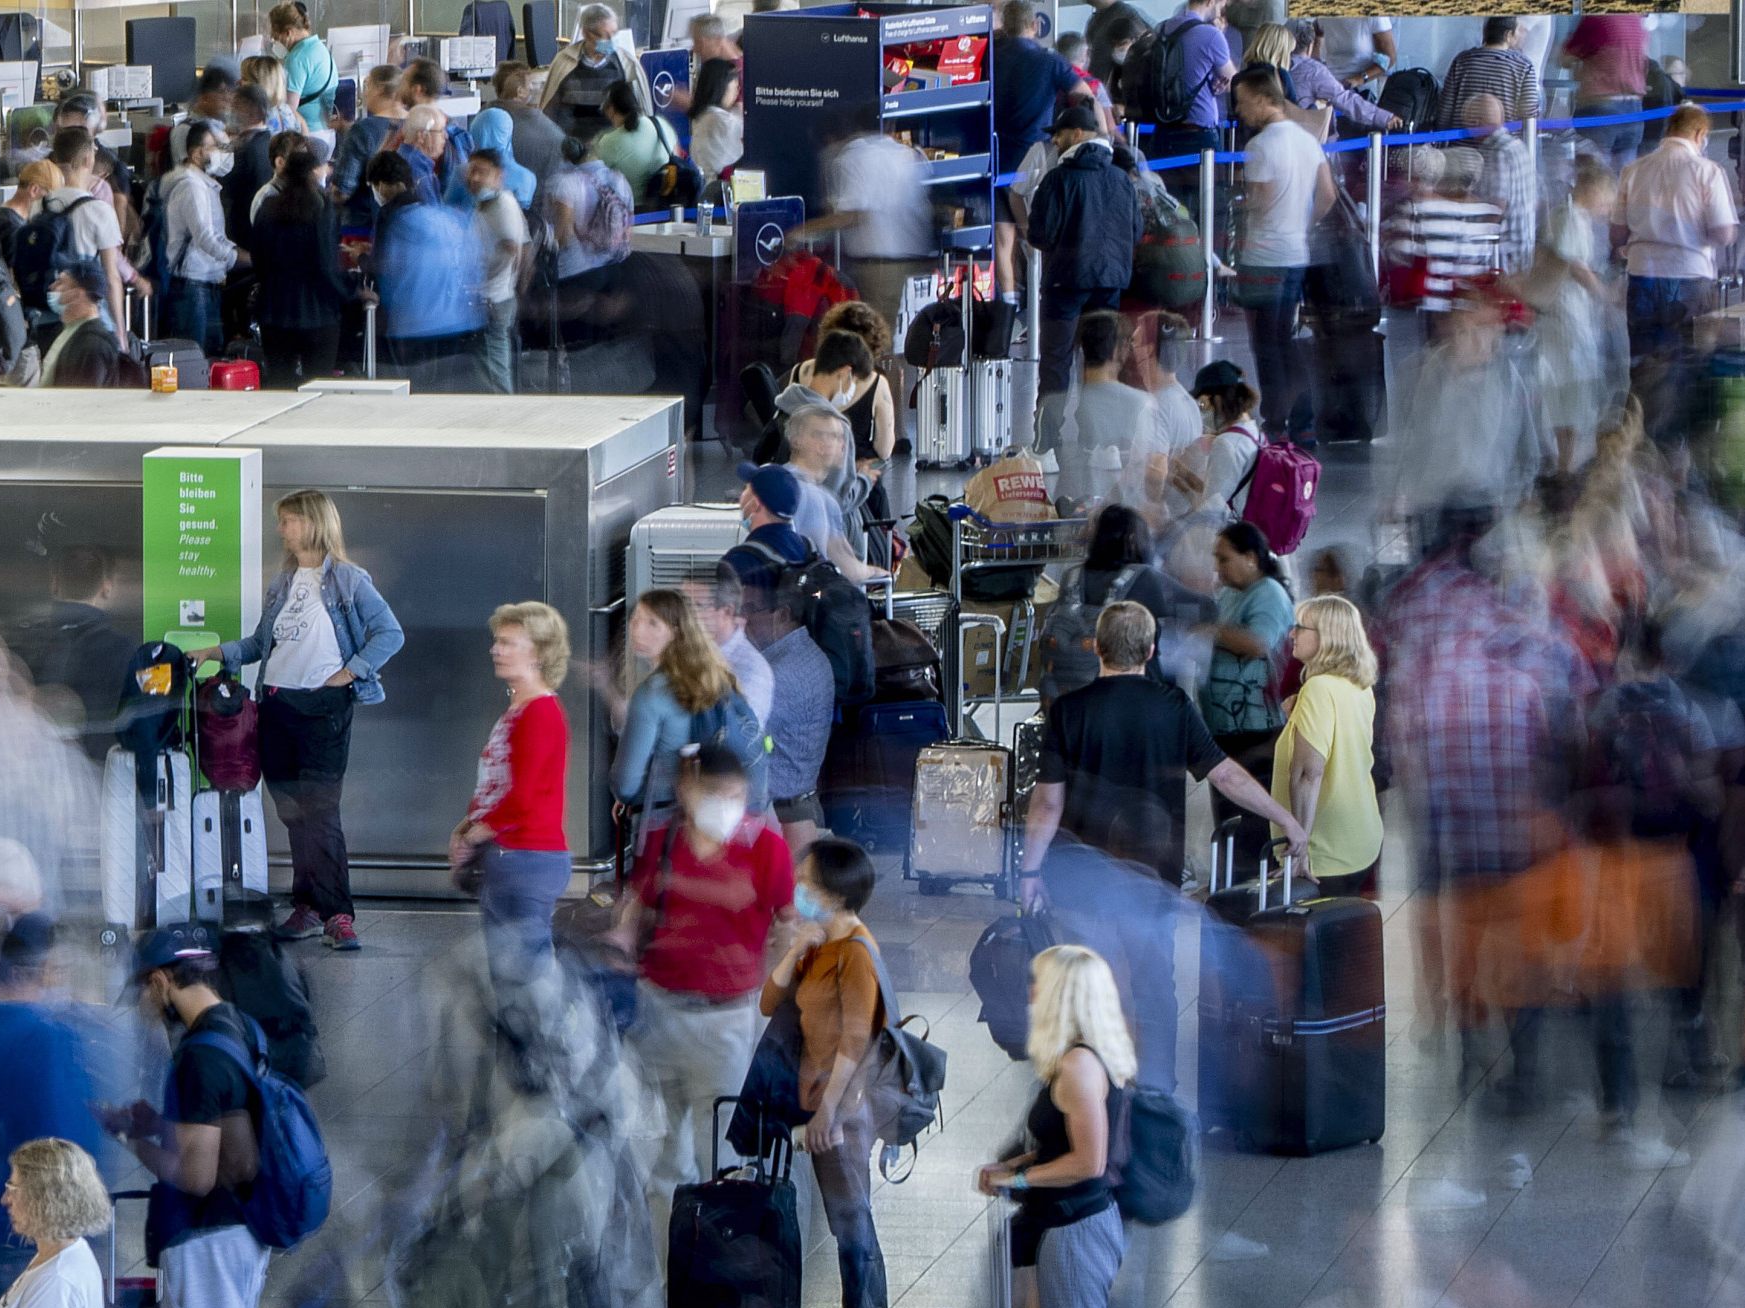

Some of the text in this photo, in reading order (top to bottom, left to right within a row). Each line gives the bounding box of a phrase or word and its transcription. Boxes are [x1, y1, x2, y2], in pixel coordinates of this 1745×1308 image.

[755, 86, 840, 98] Bitte bedienen Sie sich
[755, 96, 824, 108] Please help yourself
[179, 471, 204, 483] Bitte
[997, 475, 1046, 492] REWE
[179, 487, 216, 499] bleiben
[179, 502, 196, 514] Sie
[179, 519, 218, 531] gesund.
[179, 534, 212, 545] Please
[179, 550, 200, 562] stay
[178, 564, 217, 578] healthy.
